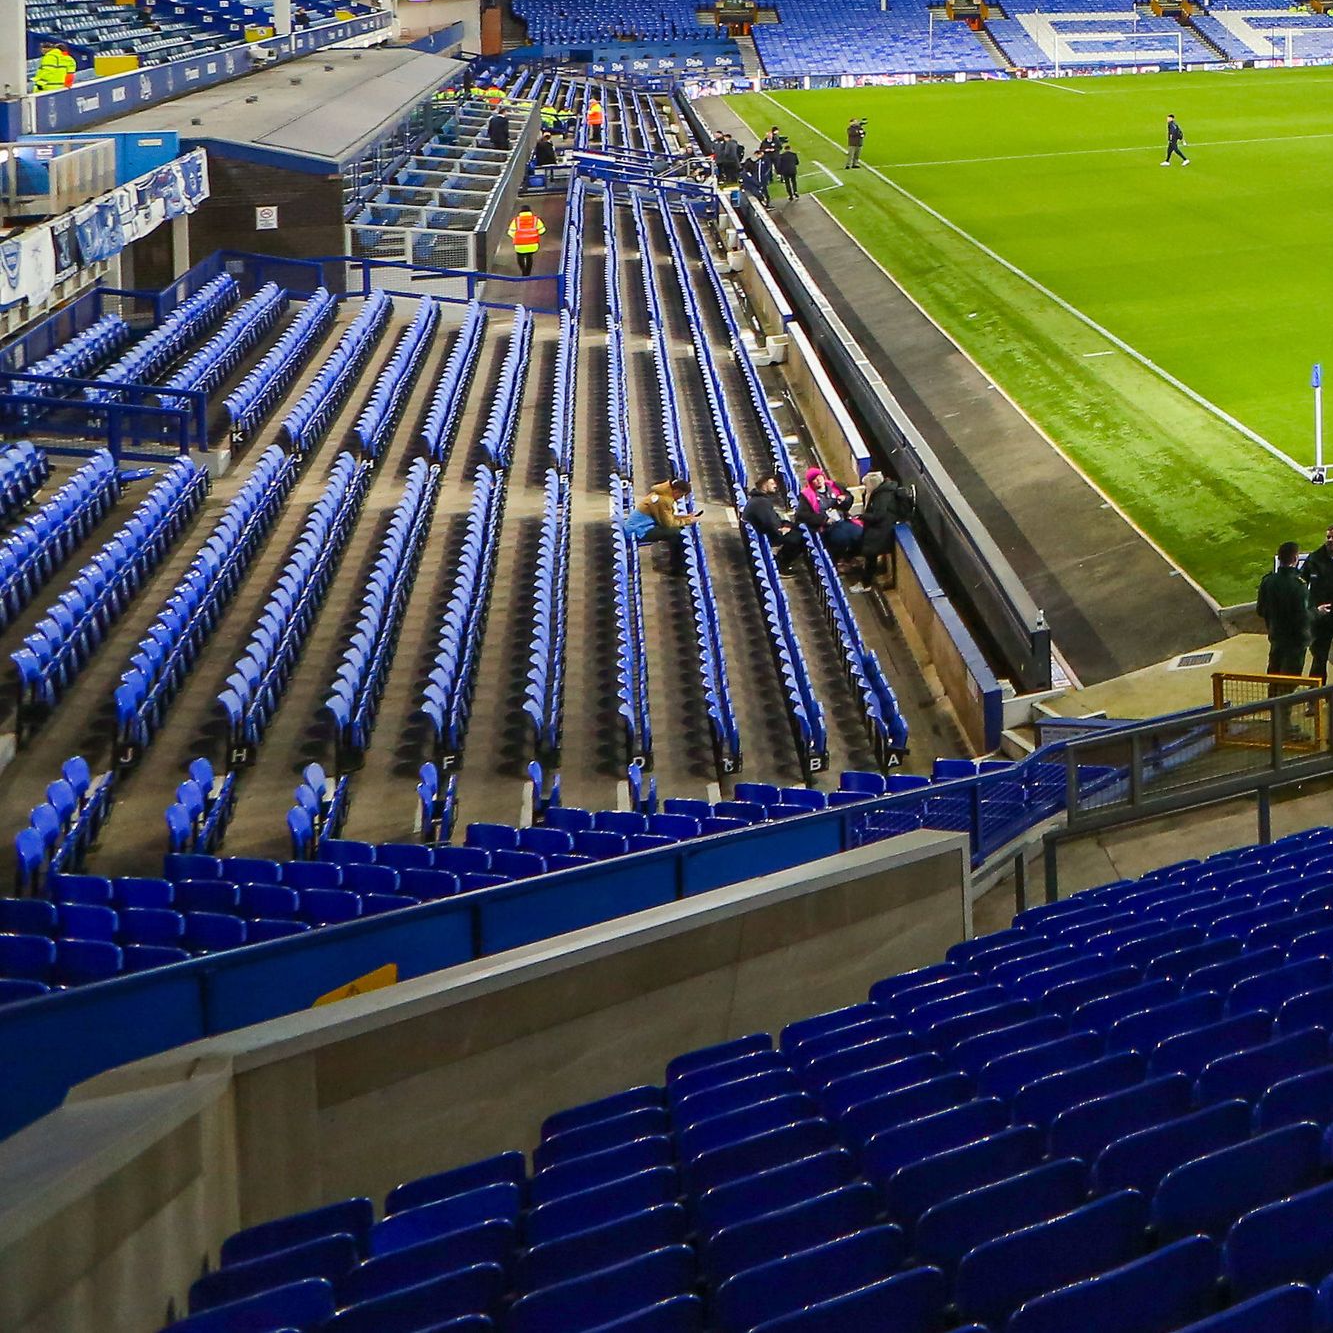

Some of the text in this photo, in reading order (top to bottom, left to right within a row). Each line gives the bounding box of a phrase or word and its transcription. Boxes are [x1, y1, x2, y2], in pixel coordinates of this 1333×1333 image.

[232, 432, 243, 442] K
[120, 747, 133, 763] J
[231, 748, 248, 763] H
[887, 754, 899, 767] A
[443, 755, 456, 770] F
[810, 758, 821, 770] B
